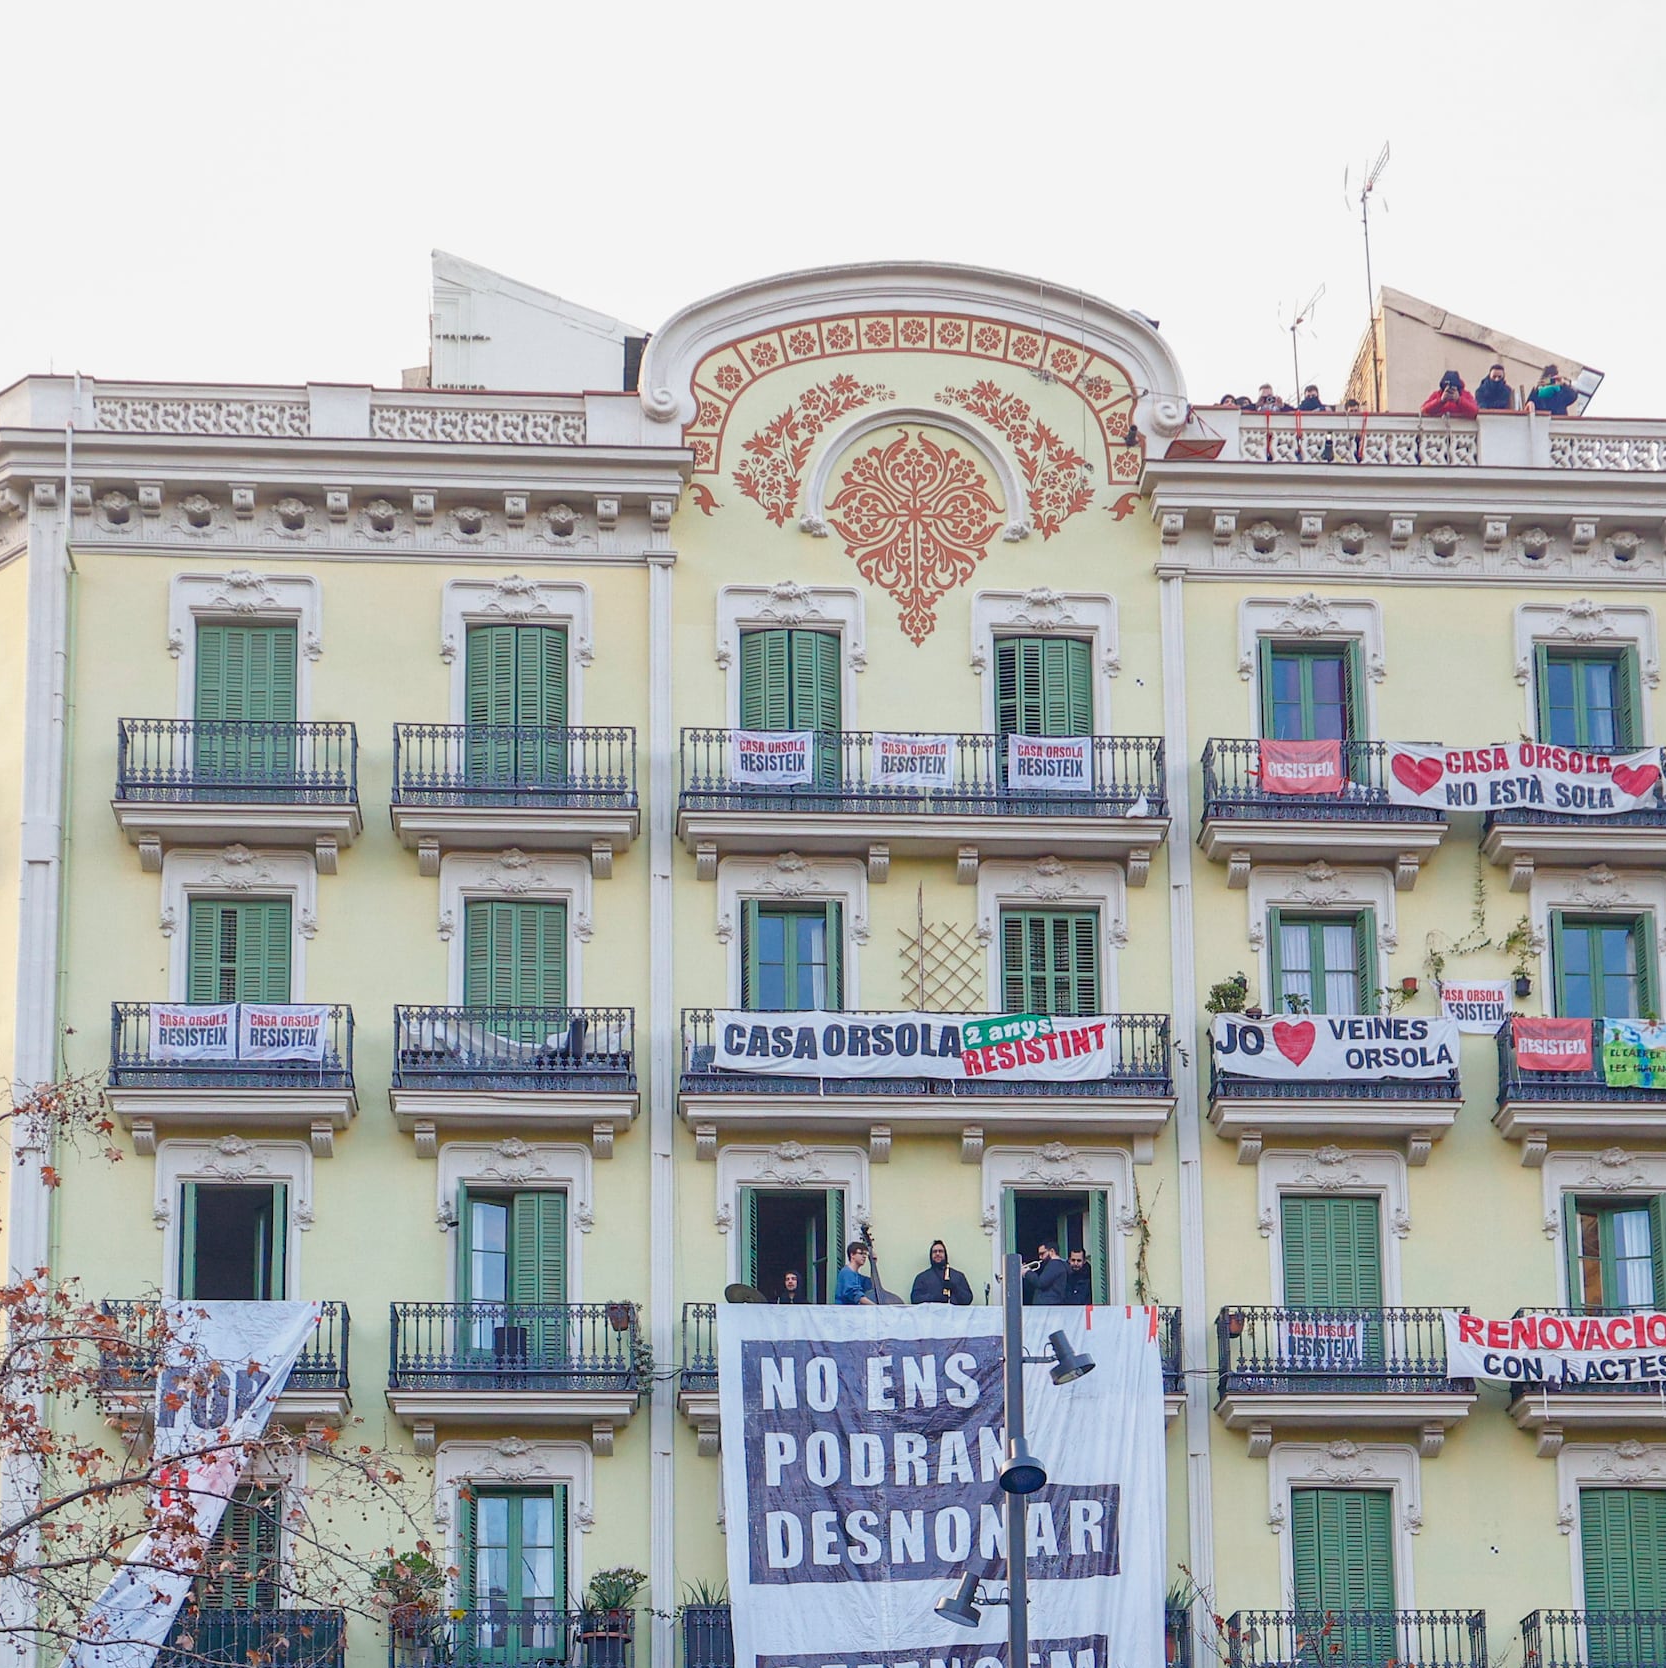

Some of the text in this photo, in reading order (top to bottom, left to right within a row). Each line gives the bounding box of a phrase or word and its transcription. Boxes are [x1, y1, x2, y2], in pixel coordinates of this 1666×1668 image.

[739, 740, 805, 754] CASA ORSOLA
[881, 741, 947, 756] CASA ORSOLA
[1017, 744, 1083, 758] CASA ORSOLA
[740, 753, 805, 772] RESISTEIX
[881, 755, 946, 775] RESISTEIX
[1017, 757, 1083, 777] RESISTEIX
[1445, 743, 1613, 774] CASA ORSOLA
[1267, 760, 1335, 779] RESISTEIX
[1445, 774, 1614, 809] NO ESTÀ SOLA
[1466, 989, 1504, 1002] ORSOLA
[159, 1013, 228, 1026] CASA ORSOLA
[250, 1013, 320, 1027] CASA ORSOLA
[1447, 1002, 1504, 1022] ESISTEIX
[158, 1026, 228, 1047] RESISTEIX
[249, 1027, 319, 1048] RESISTEIX
[965, 1015, 1052, 1045] 2 anys
[1215, 1023, 1265, 1056] JO
[723, 1022, 963, 1060] CASA ORSOLA
[962, 1022, 1107, 1077] RESISTINT
[1517, 1036, 1588, 1057] RESISTEIX
[1345, 1043, 1454, 1070] ORSOLA
[760, 1352, 981, 1413] NO ENS
[764, 1426, 1007, 1488] PODRAN
[765, 1499, 1104, 1569] DESNONAR
